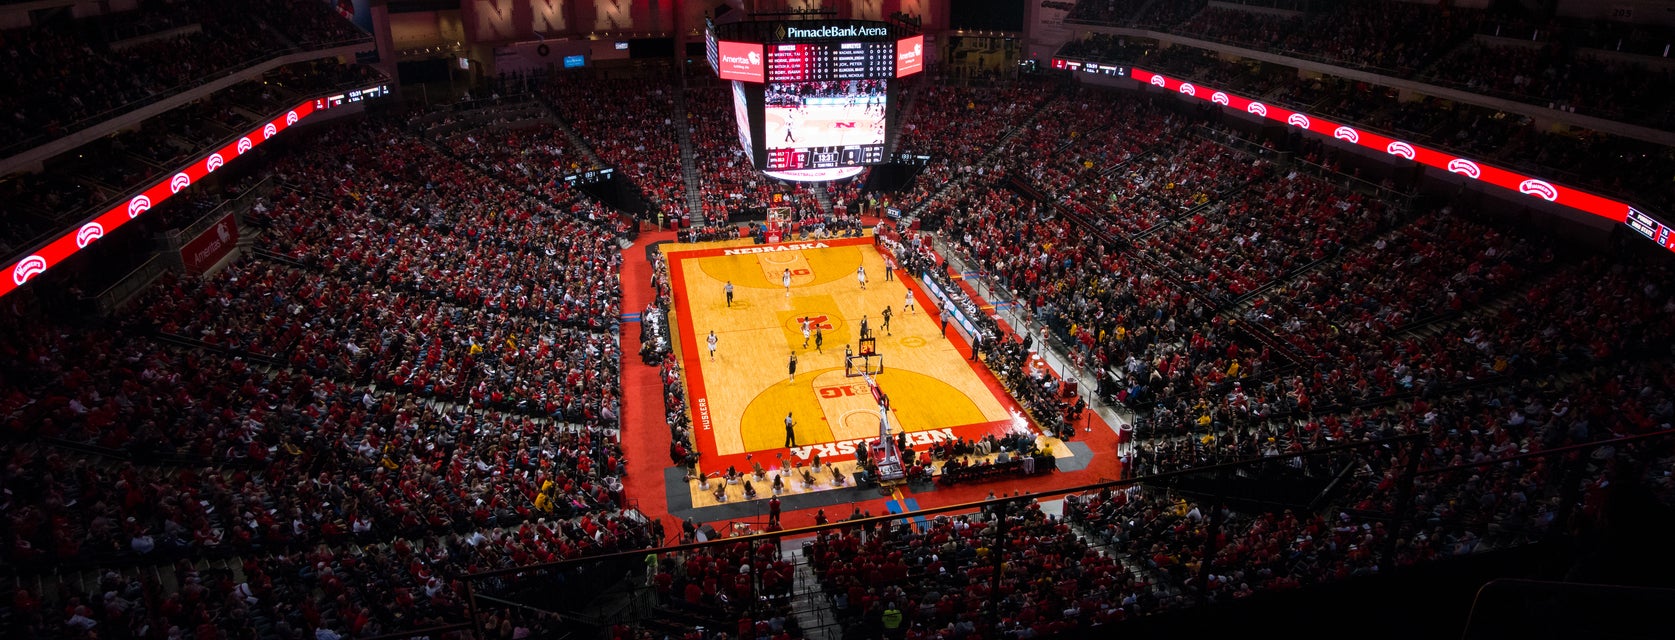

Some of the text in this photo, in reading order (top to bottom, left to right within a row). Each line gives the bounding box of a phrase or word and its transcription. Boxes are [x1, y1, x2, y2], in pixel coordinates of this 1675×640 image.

[858, 26, 886, 36] Arena
[722, 54, 750, 64] Ameritas
[195, 240, 221, 265] Ameritas
[724, 242, 829, 256] NEBRASKA
[699, 398, 710, 430] HUSKERS
[791, 428, 958, 460] NEBSKA
